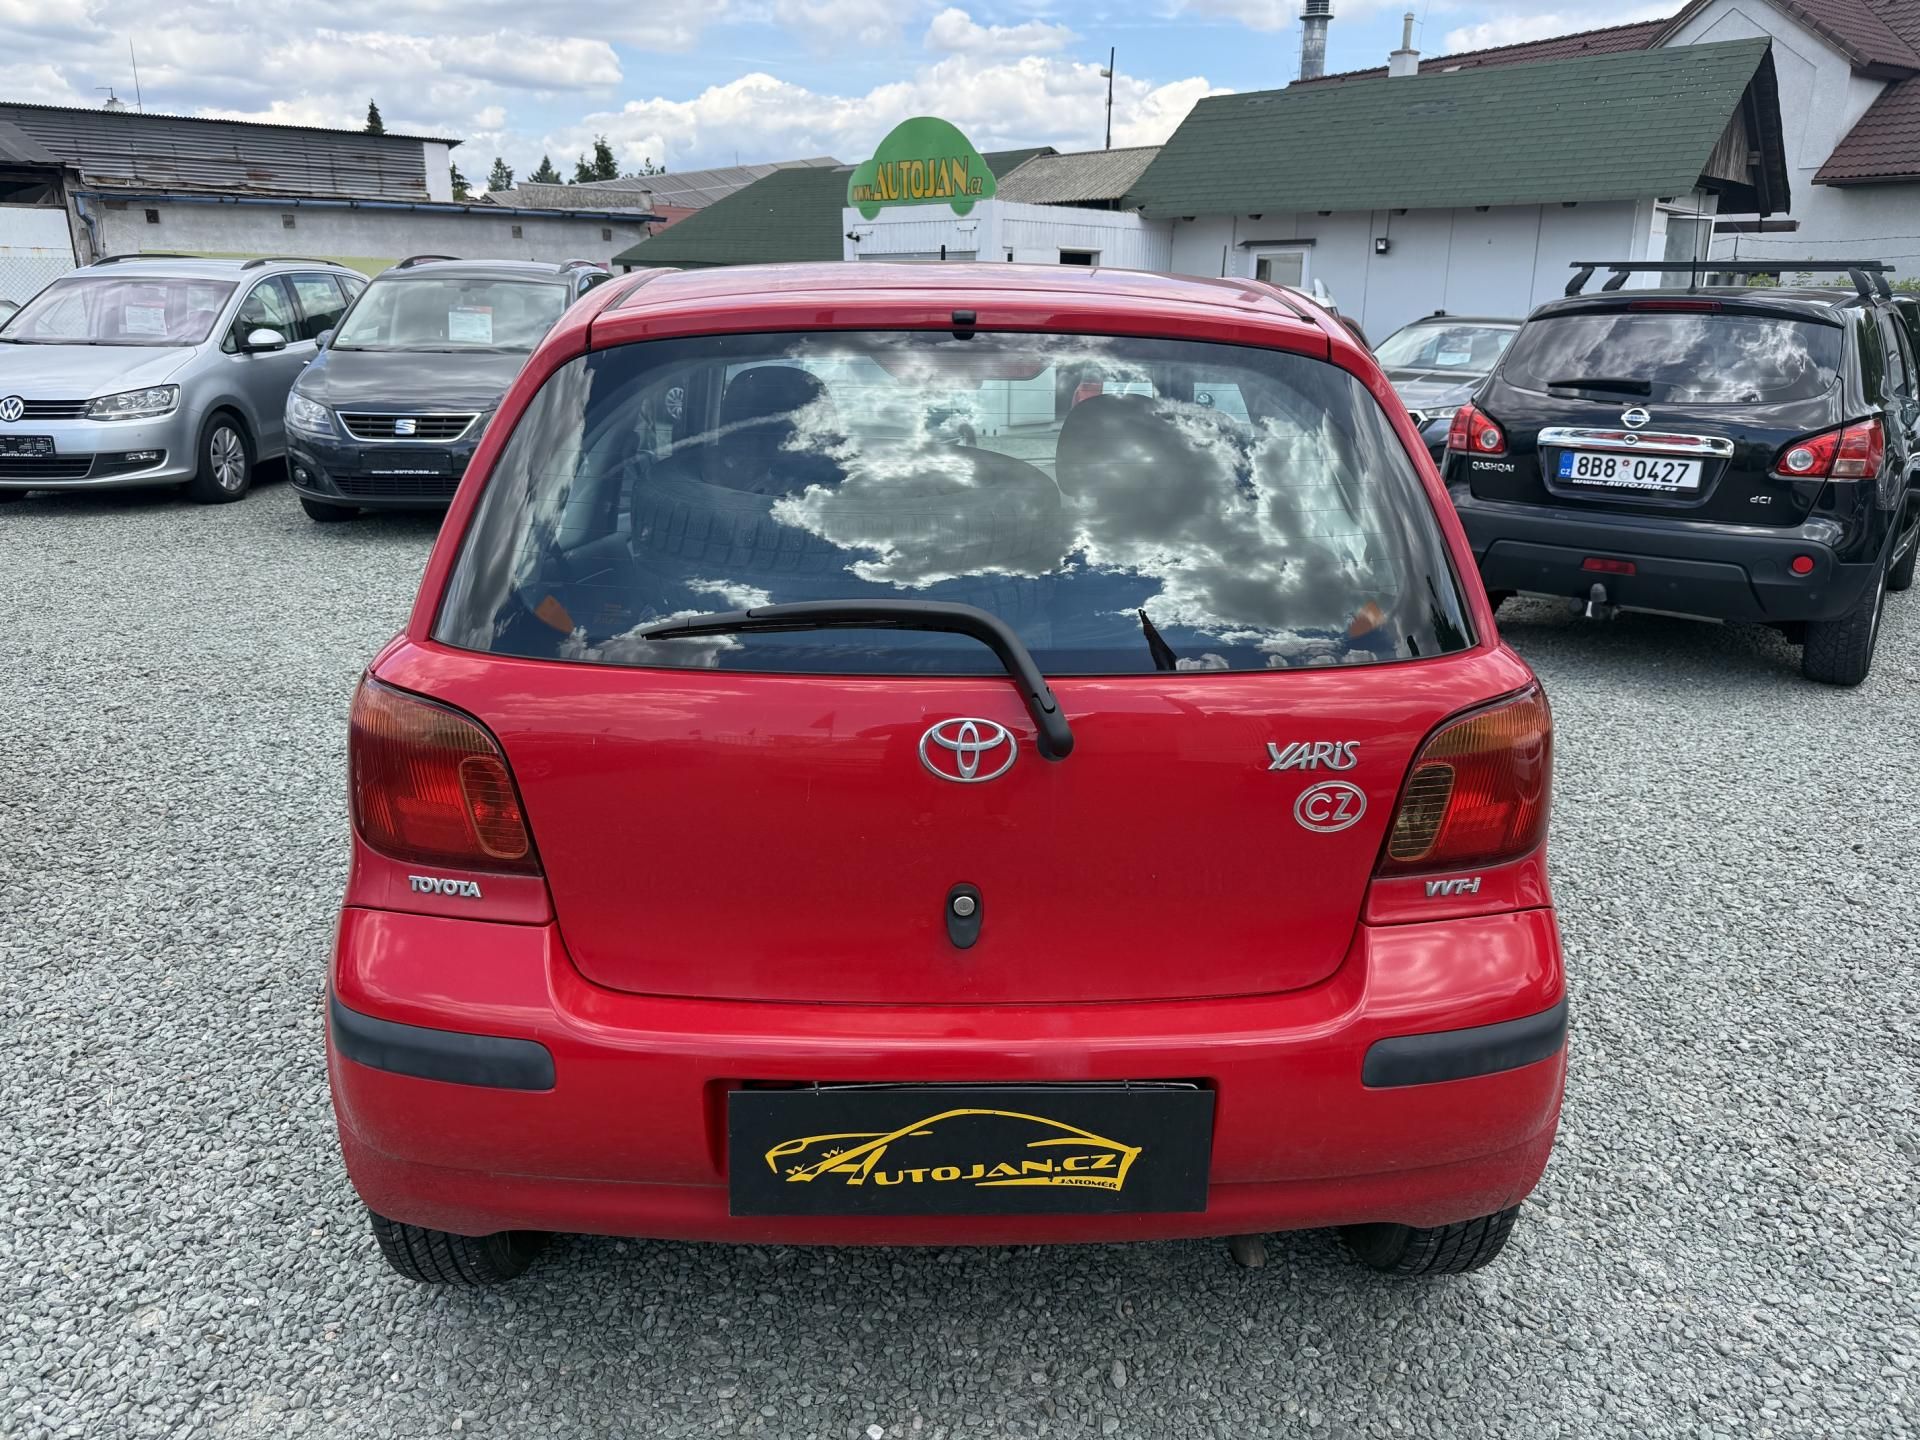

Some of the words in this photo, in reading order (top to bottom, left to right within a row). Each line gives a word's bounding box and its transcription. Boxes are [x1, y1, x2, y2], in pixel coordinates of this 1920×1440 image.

[1472, 461, 1515, 473] QASHQAI
[1577, 456, 1617, 478] 8B8
[1633, 460, 1690, 484] 0427
[1305, 791, 1354, 821] CZ
[408, 875, 482, 898] TOYOTA
